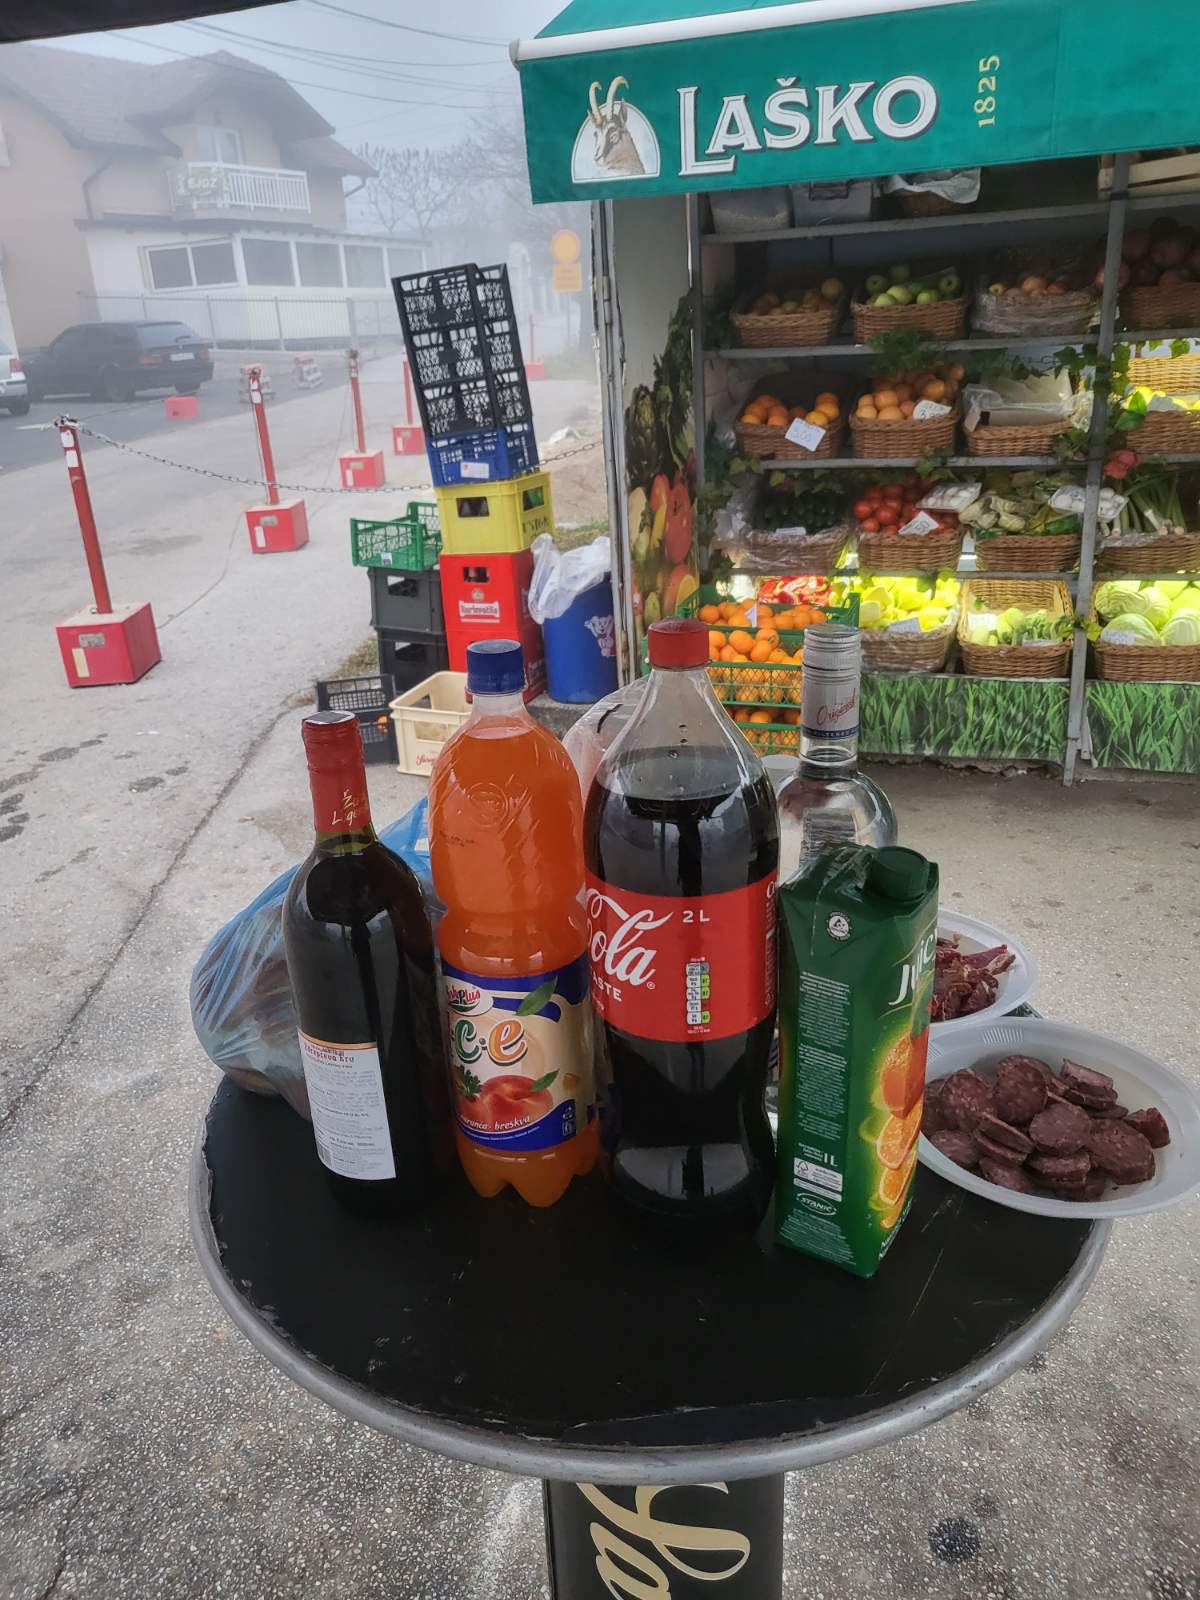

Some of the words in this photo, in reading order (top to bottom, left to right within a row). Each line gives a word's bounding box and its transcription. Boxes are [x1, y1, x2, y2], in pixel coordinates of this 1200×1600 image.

[974, 55, 1000, 129] 1825
[677, 76, 938, 176] LAŠKO
[682, 910, 694, 923] 2
[699, 910, 711, 923] L
[494, 1115, 530, 1130] breskva
